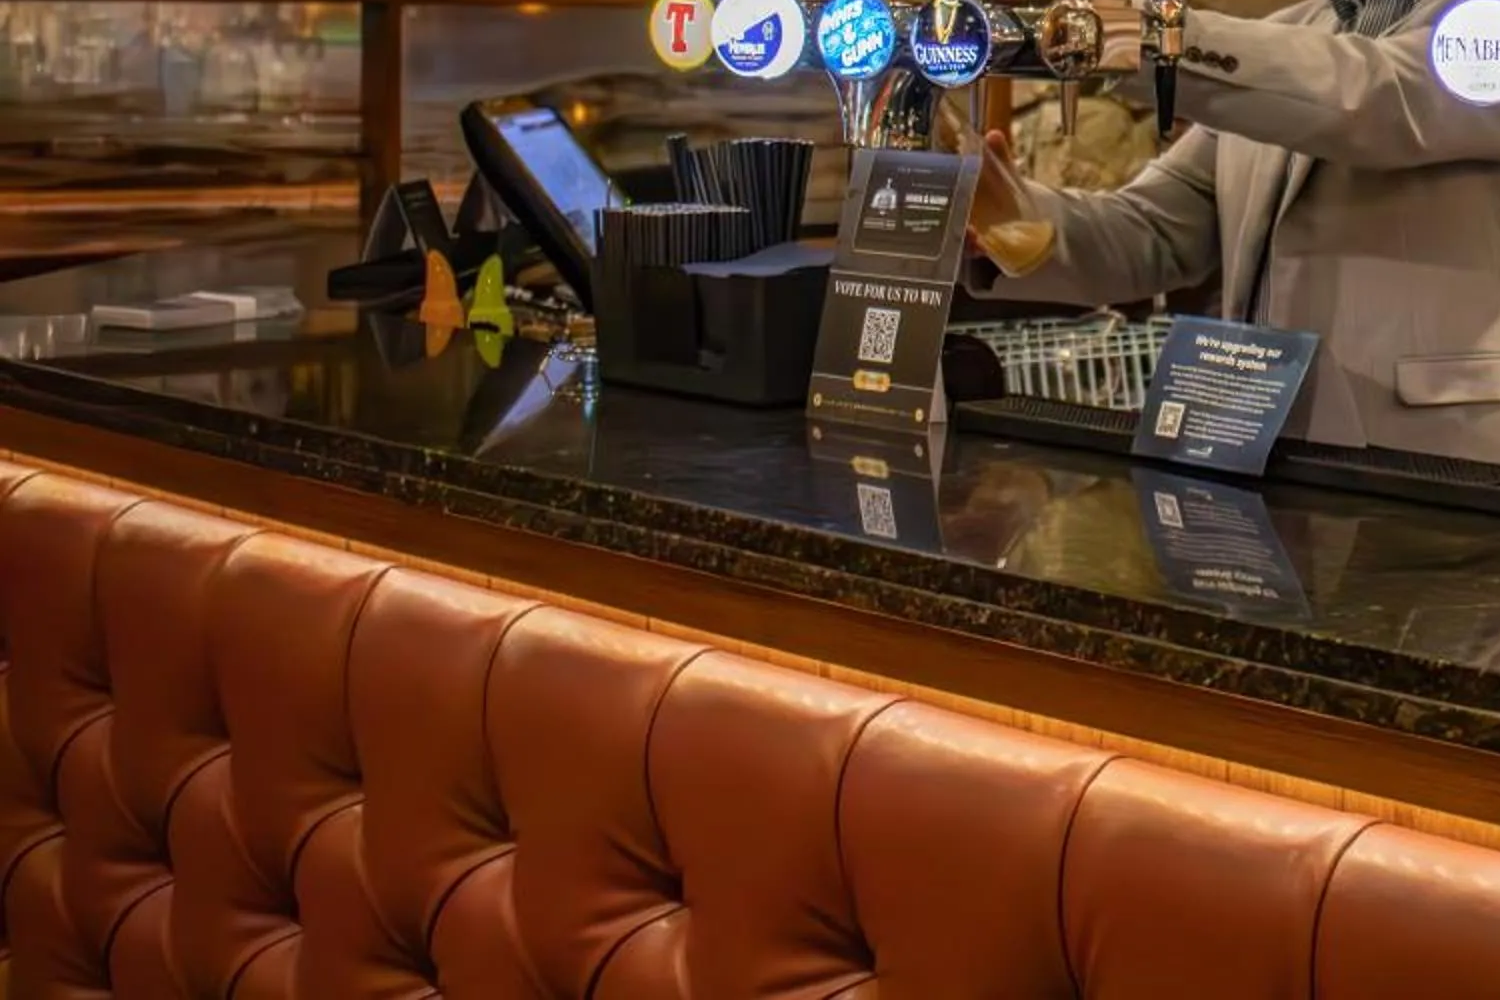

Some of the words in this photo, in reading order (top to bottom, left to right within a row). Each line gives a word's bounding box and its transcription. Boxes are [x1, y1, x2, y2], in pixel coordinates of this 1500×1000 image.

[666, 3, 695, 53] T
[841, 31, 883, 67] GUNN
[914, 43, 979, 65] GUINNESS
[835, 280, 864, 297] VOTE
[864, 283, 886, 300] FOR
[887, 285, 901, 301] US
[903, 287, 919, 303] TO
[920, 289, 943, 306] WIN
